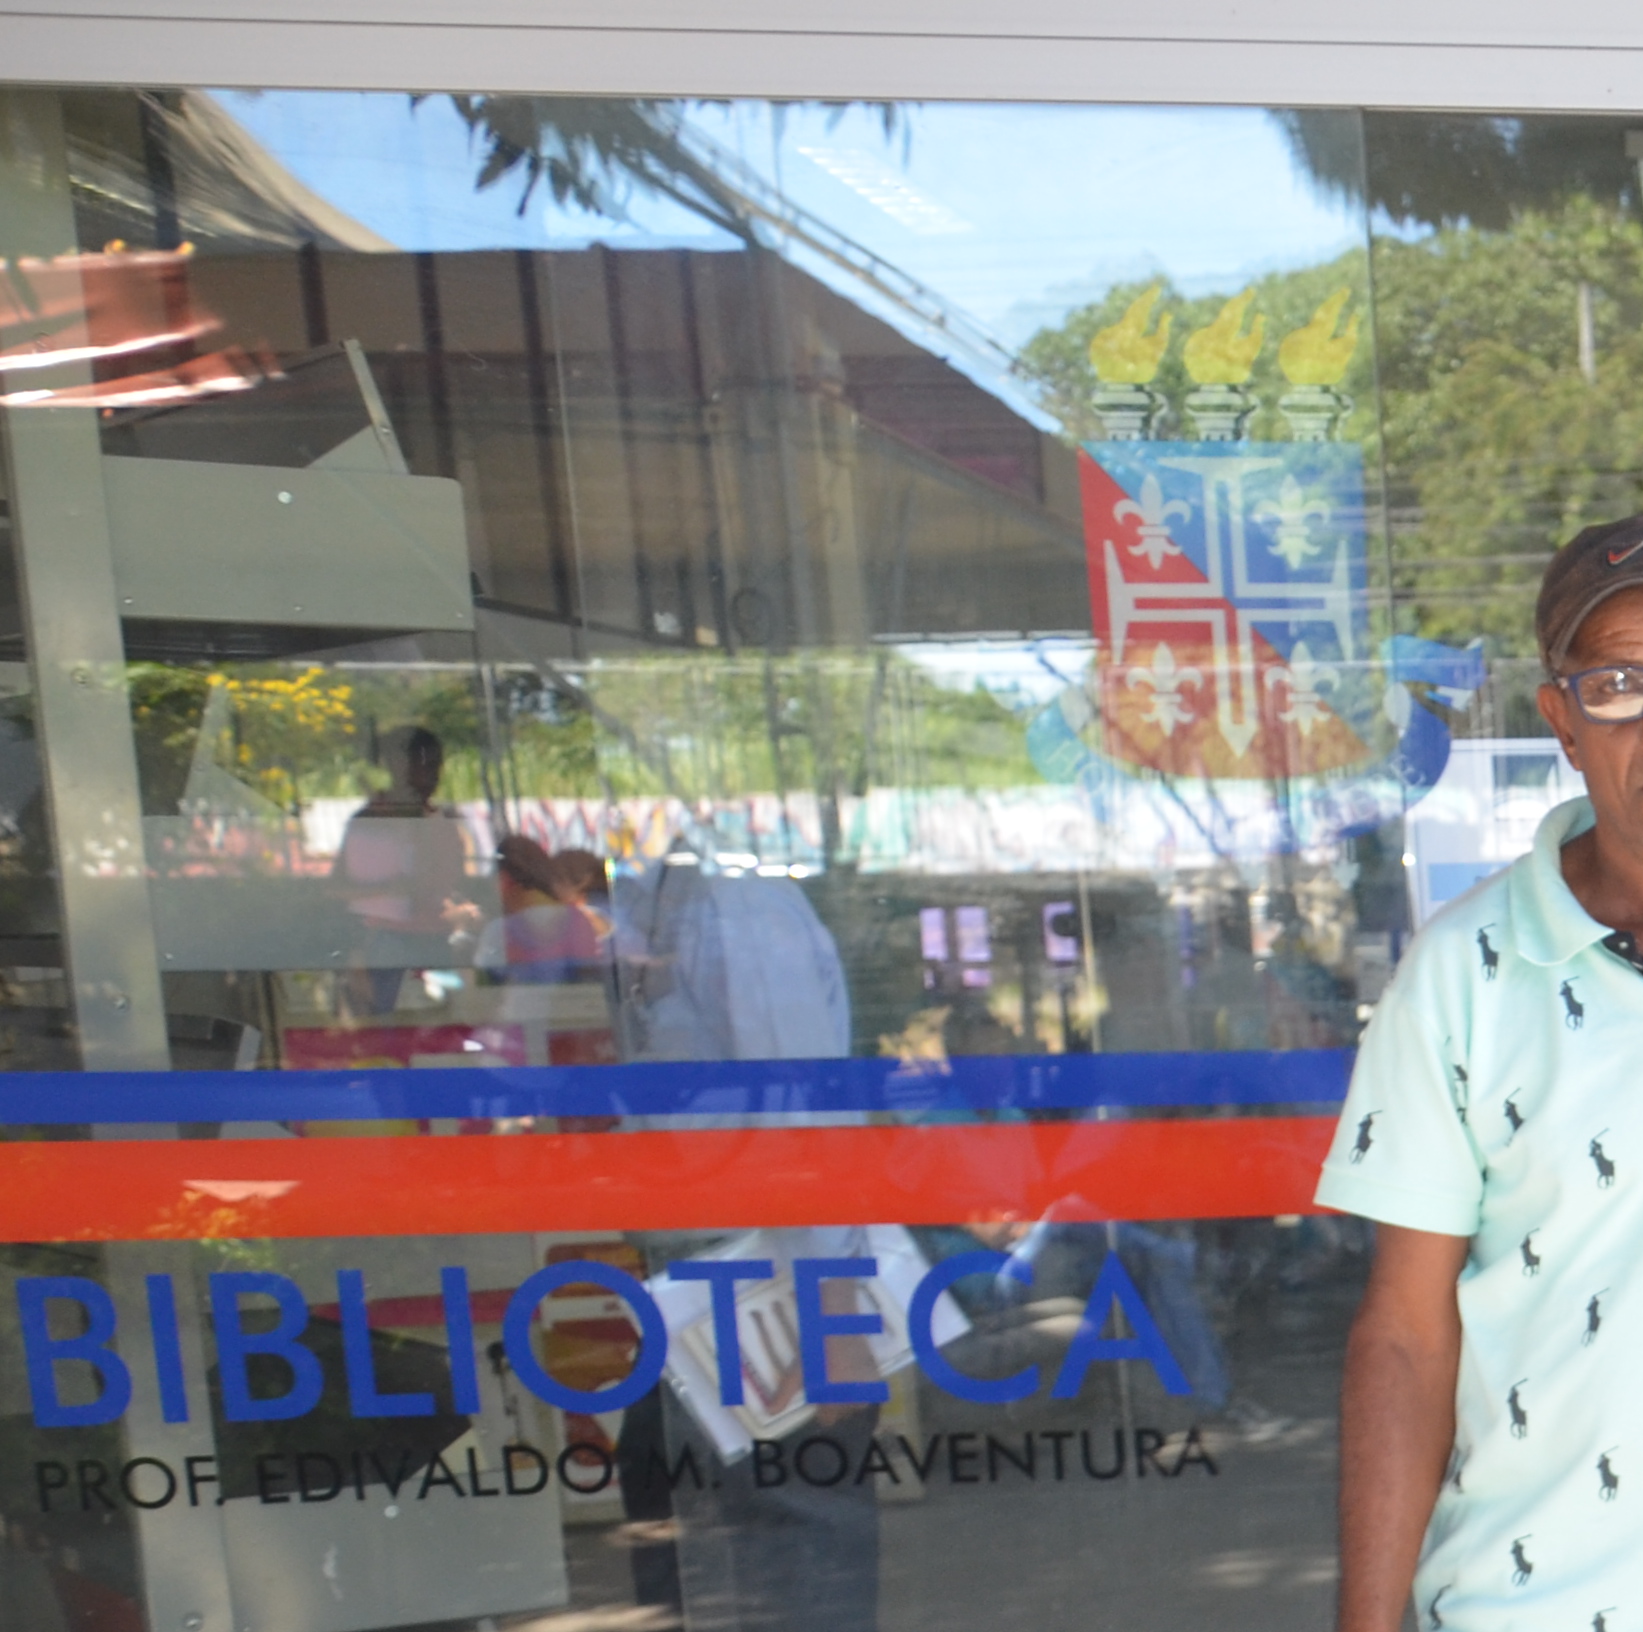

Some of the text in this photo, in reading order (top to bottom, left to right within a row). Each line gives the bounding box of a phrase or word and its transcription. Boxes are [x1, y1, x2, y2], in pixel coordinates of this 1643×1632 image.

[17, 1248, 1194, 1428] BIBLIOTECA
[35, 1428, 1221, 1512] PROF. EDIVALDO M. BOAVENTURA
